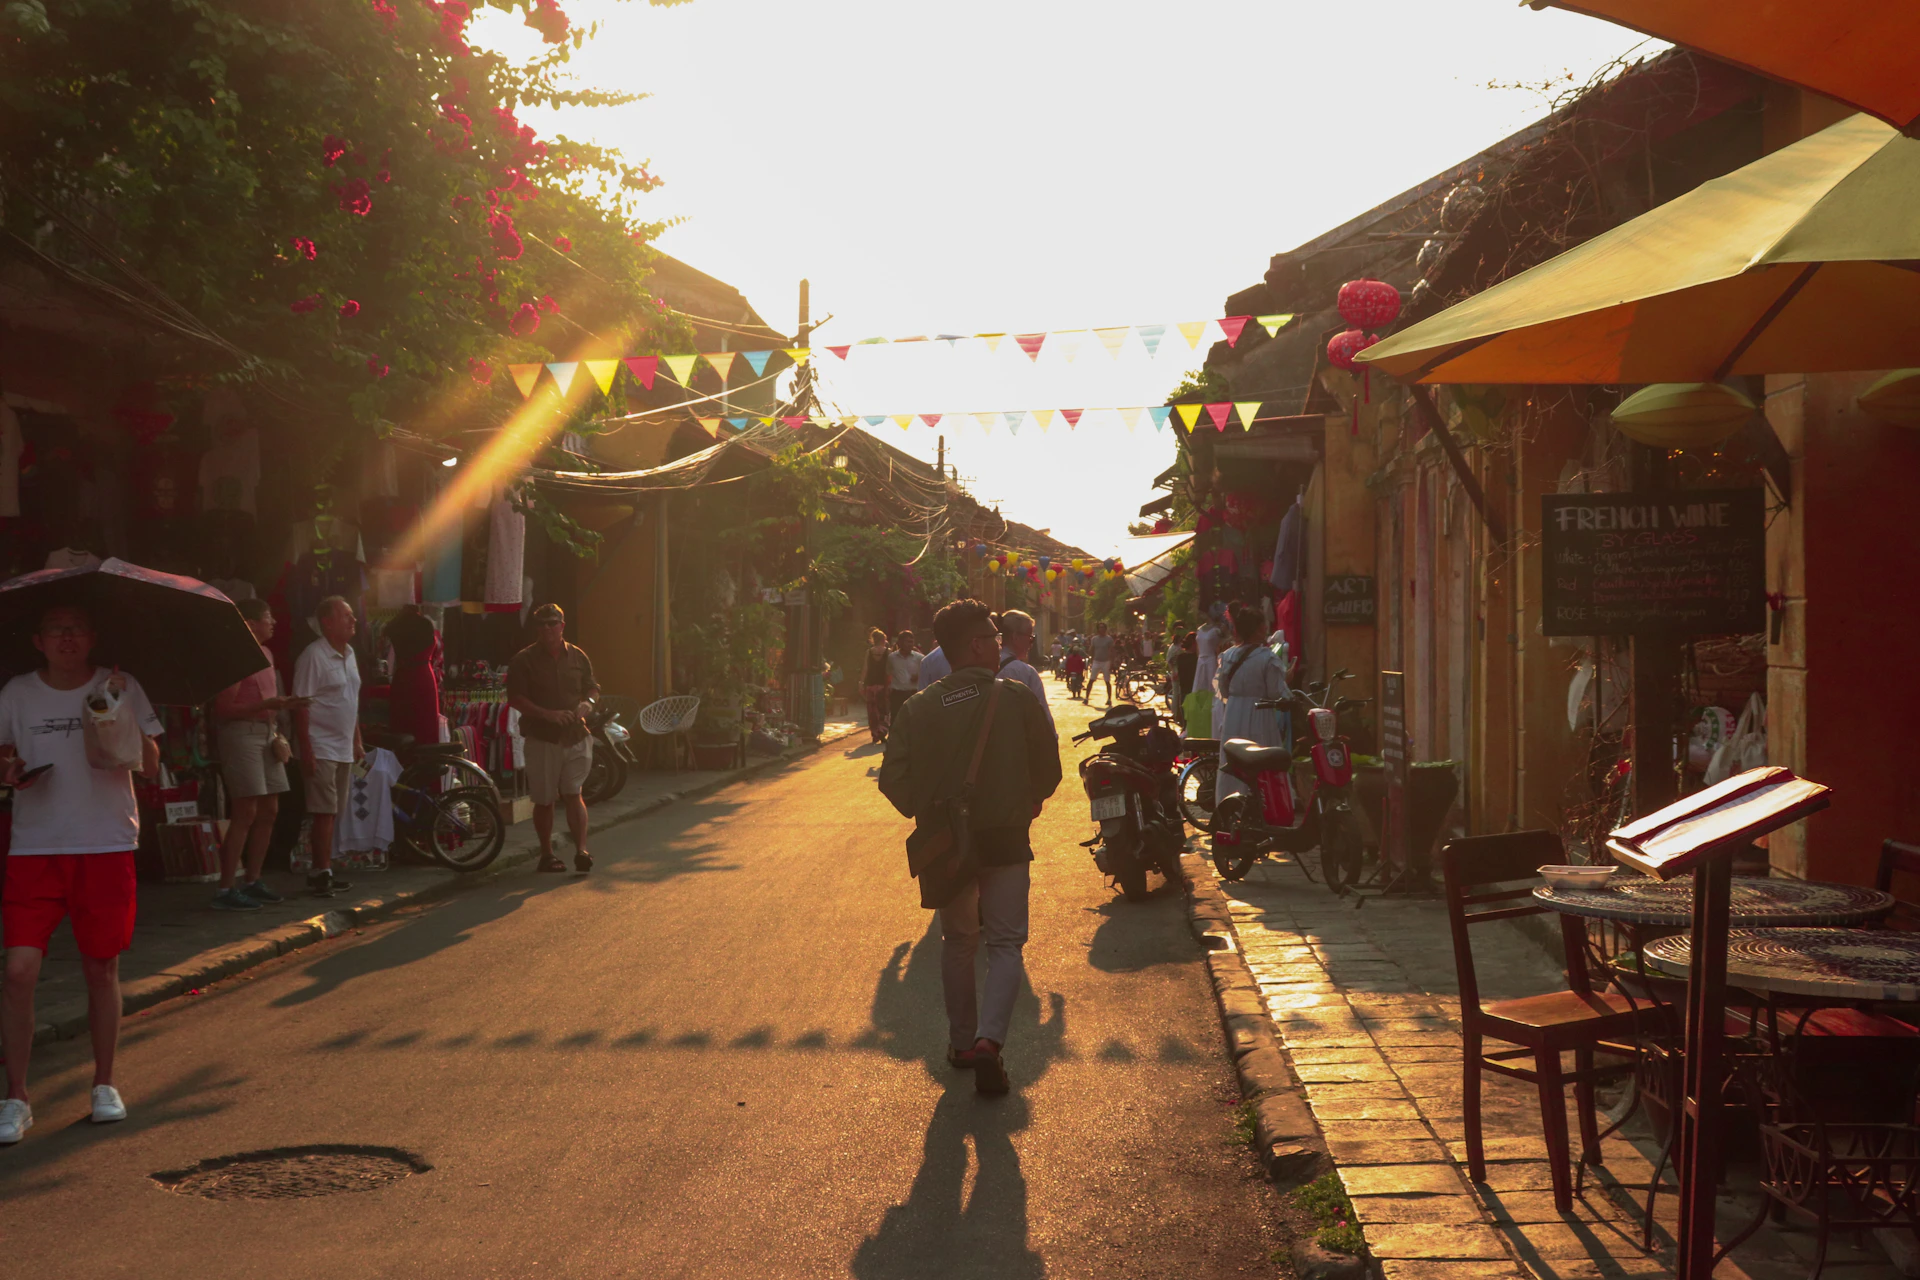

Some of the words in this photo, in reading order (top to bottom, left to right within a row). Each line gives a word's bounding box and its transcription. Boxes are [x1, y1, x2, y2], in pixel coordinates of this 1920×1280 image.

[1554, 504, 1660, 531] FRENCH
[1668, 502, 1731, 528] WINE
[1597, 533, 1629, 548] BY
[1634, 529, 1699, 547] GLASS
[1325, 578, 1371, 595] ART
